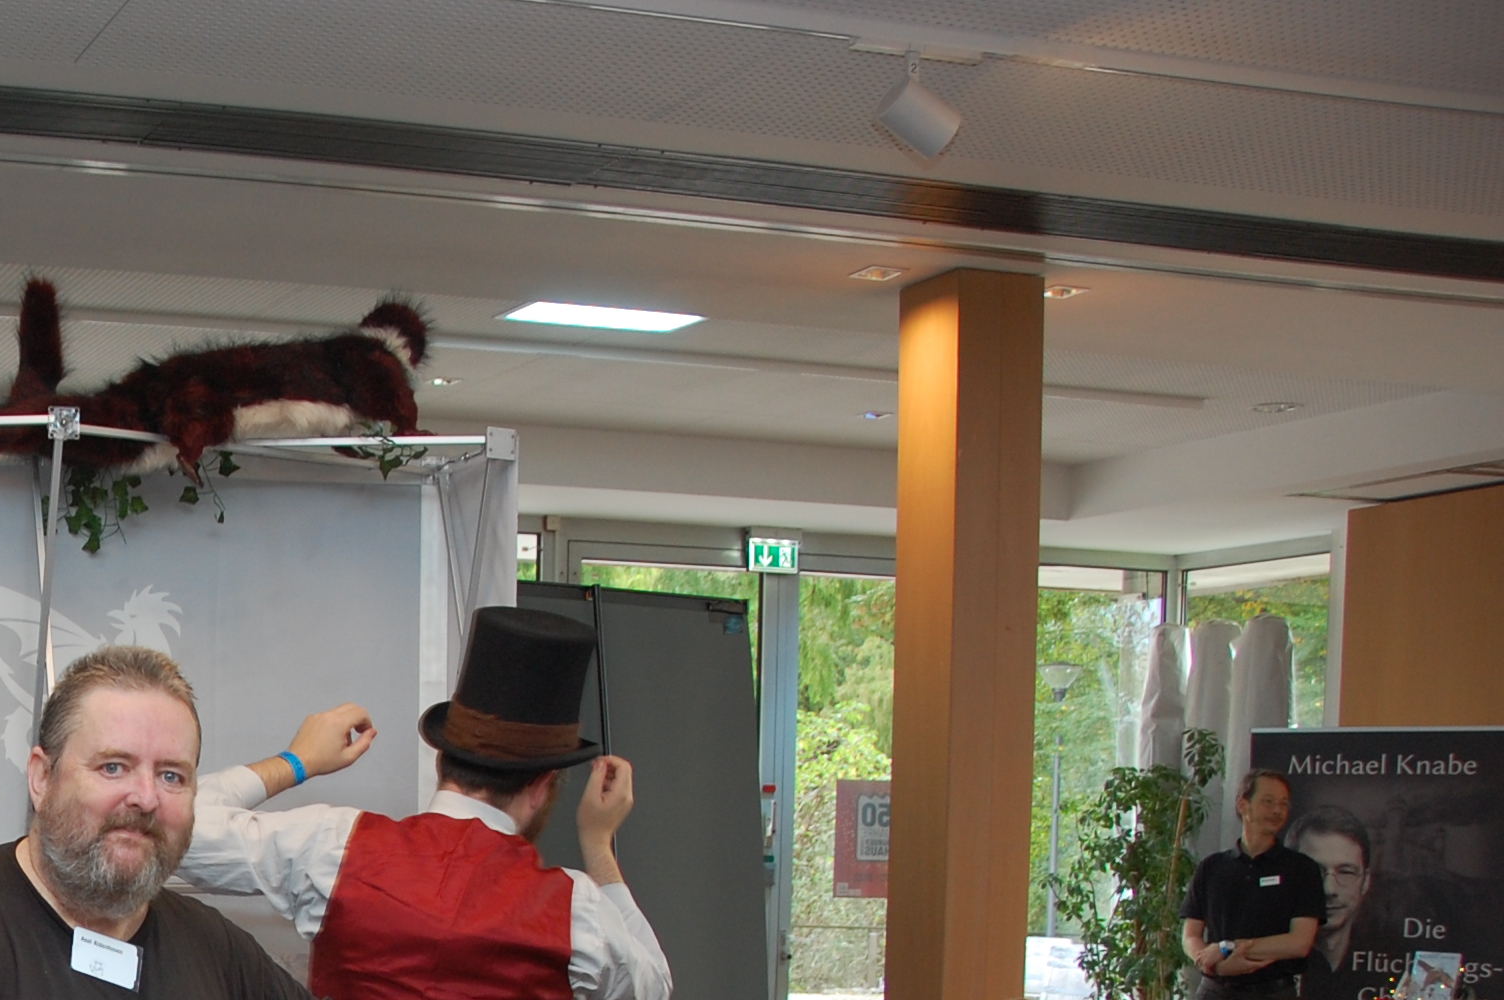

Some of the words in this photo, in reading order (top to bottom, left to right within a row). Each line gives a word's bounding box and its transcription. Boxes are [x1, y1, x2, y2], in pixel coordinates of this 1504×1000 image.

[1288, 753, 1387, 775] Michael
[1396, 753, 1478, 775] Knabe
[1403, 917, 1446, 940] Die
